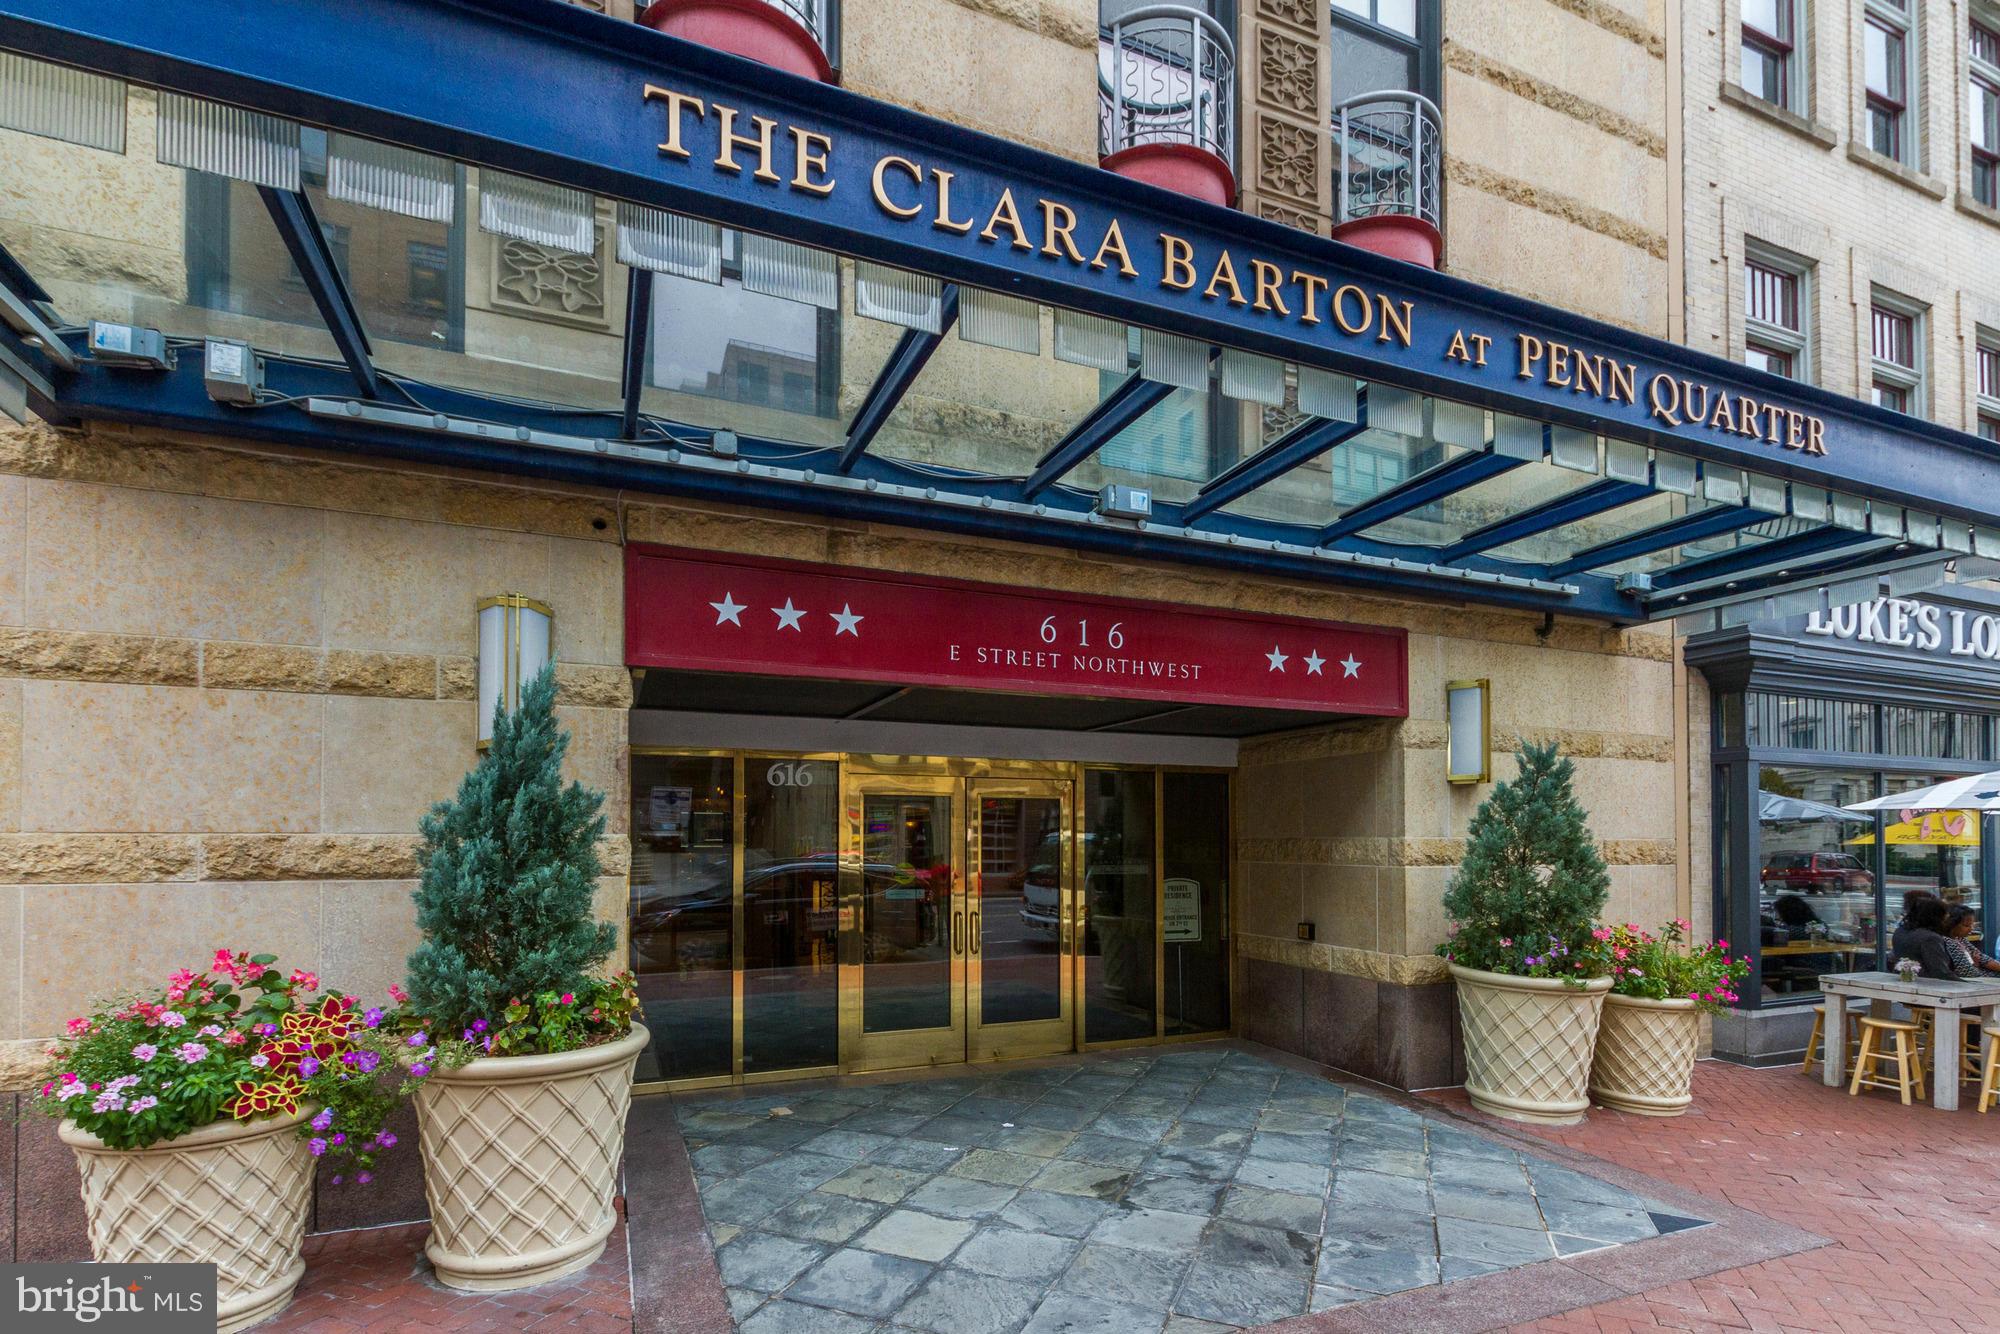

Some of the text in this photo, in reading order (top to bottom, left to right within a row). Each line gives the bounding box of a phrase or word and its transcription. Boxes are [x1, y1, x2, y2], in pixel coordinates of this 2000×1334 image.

[643, 83, 1828, 457] THE CLARA BARTON AT PENN QUARTER
[1040, 615, 1124, 649] 616
[1805, 587, 2000, 661] LUKE'S LO
[950, 644, 1202, 680] E STREET NORTHWEST
[767, 763, 813, 787] 616
